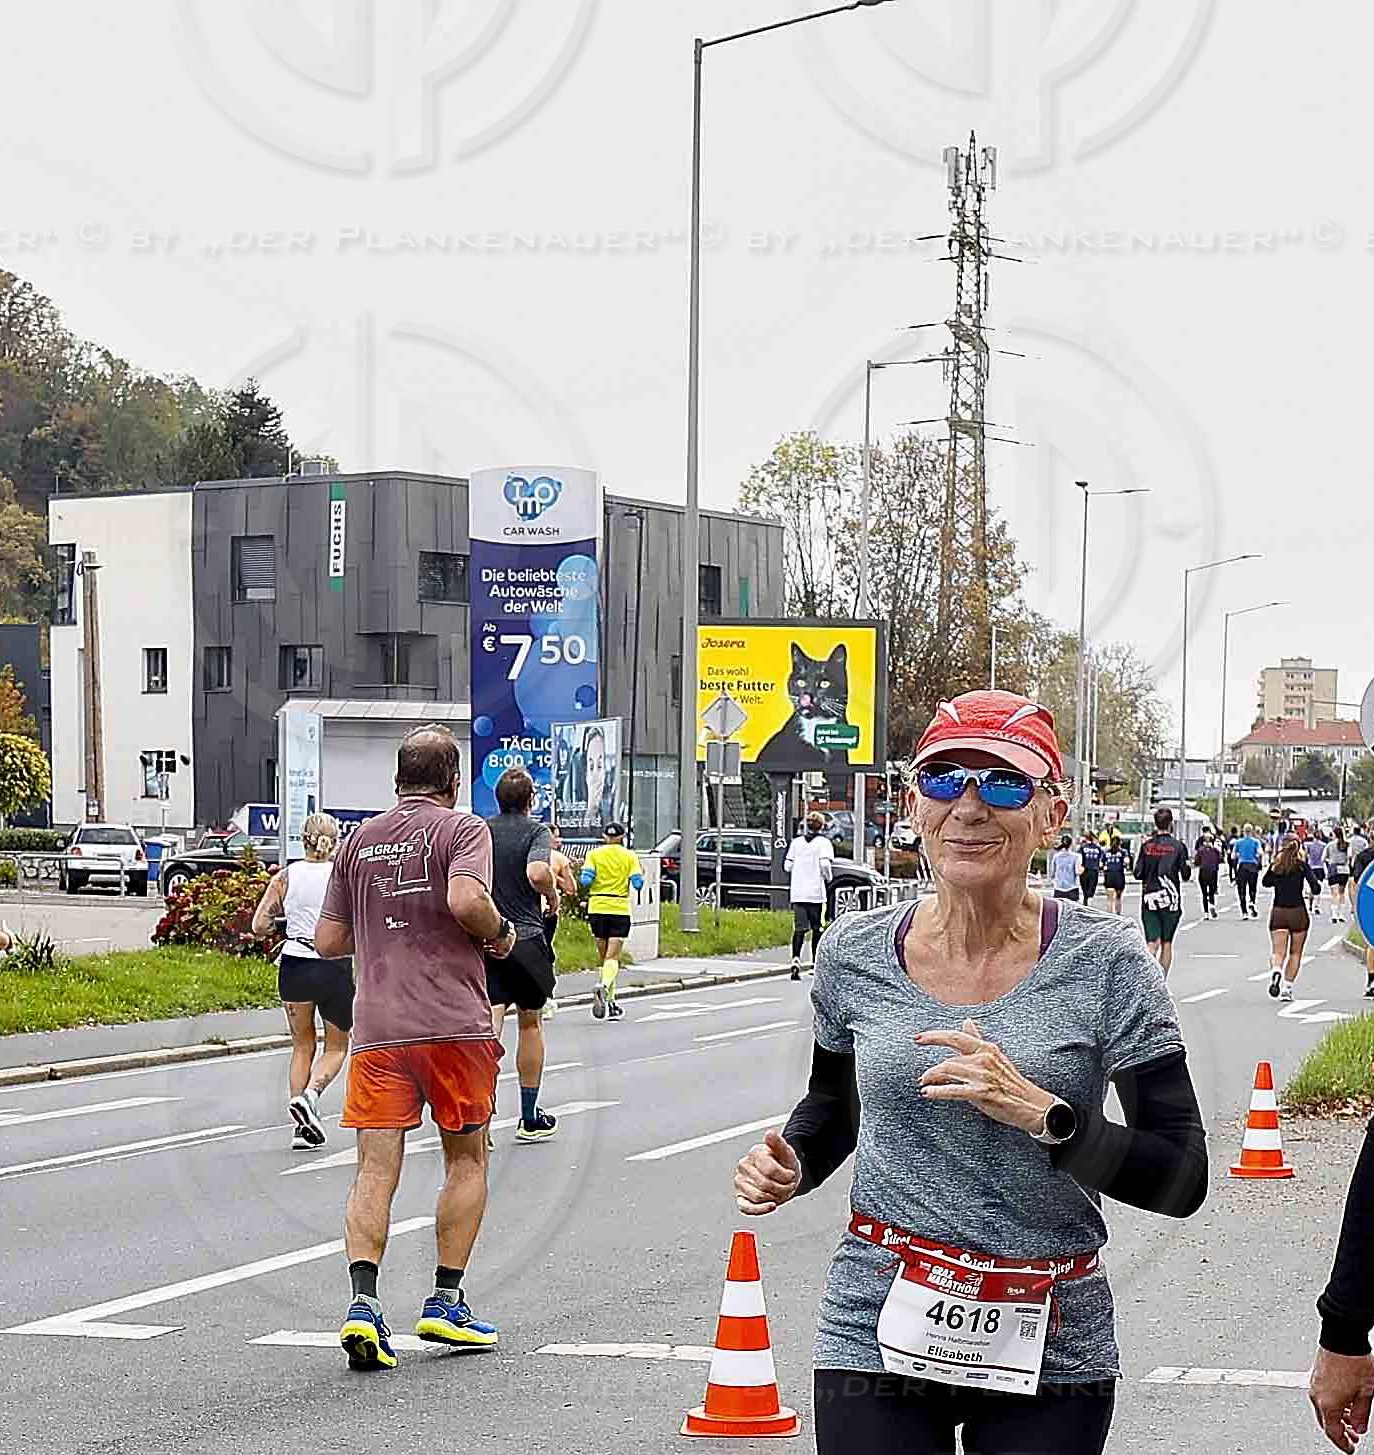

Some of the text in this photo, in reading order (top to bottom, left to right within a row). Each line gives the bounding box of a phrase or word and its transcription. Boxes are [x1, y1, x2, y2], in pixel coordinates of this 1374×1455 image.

[333, 503, 342, 573] FUCHS
[503, 527, 560, 537] CAR WASH
[482, 568, 586, 582] Die beliebteste
[489, 585, 579, 598] Autowäsche
[504, 600, 564, 613] der Welt
[483, 623, 496, 632] Ab
[707, 667, 749, 676] Das wohl
[700, 679, 776, 692] beste Futter
[500, 735, 555, 751] TÄGLIC
[931, 1265, 955, 1279] GRAZ
[926, 1273, 980, 1296] MARATHON
[926, 1300, 1001, 1333] 4618
[927, 1345, 983, 1362] Elisabeth
